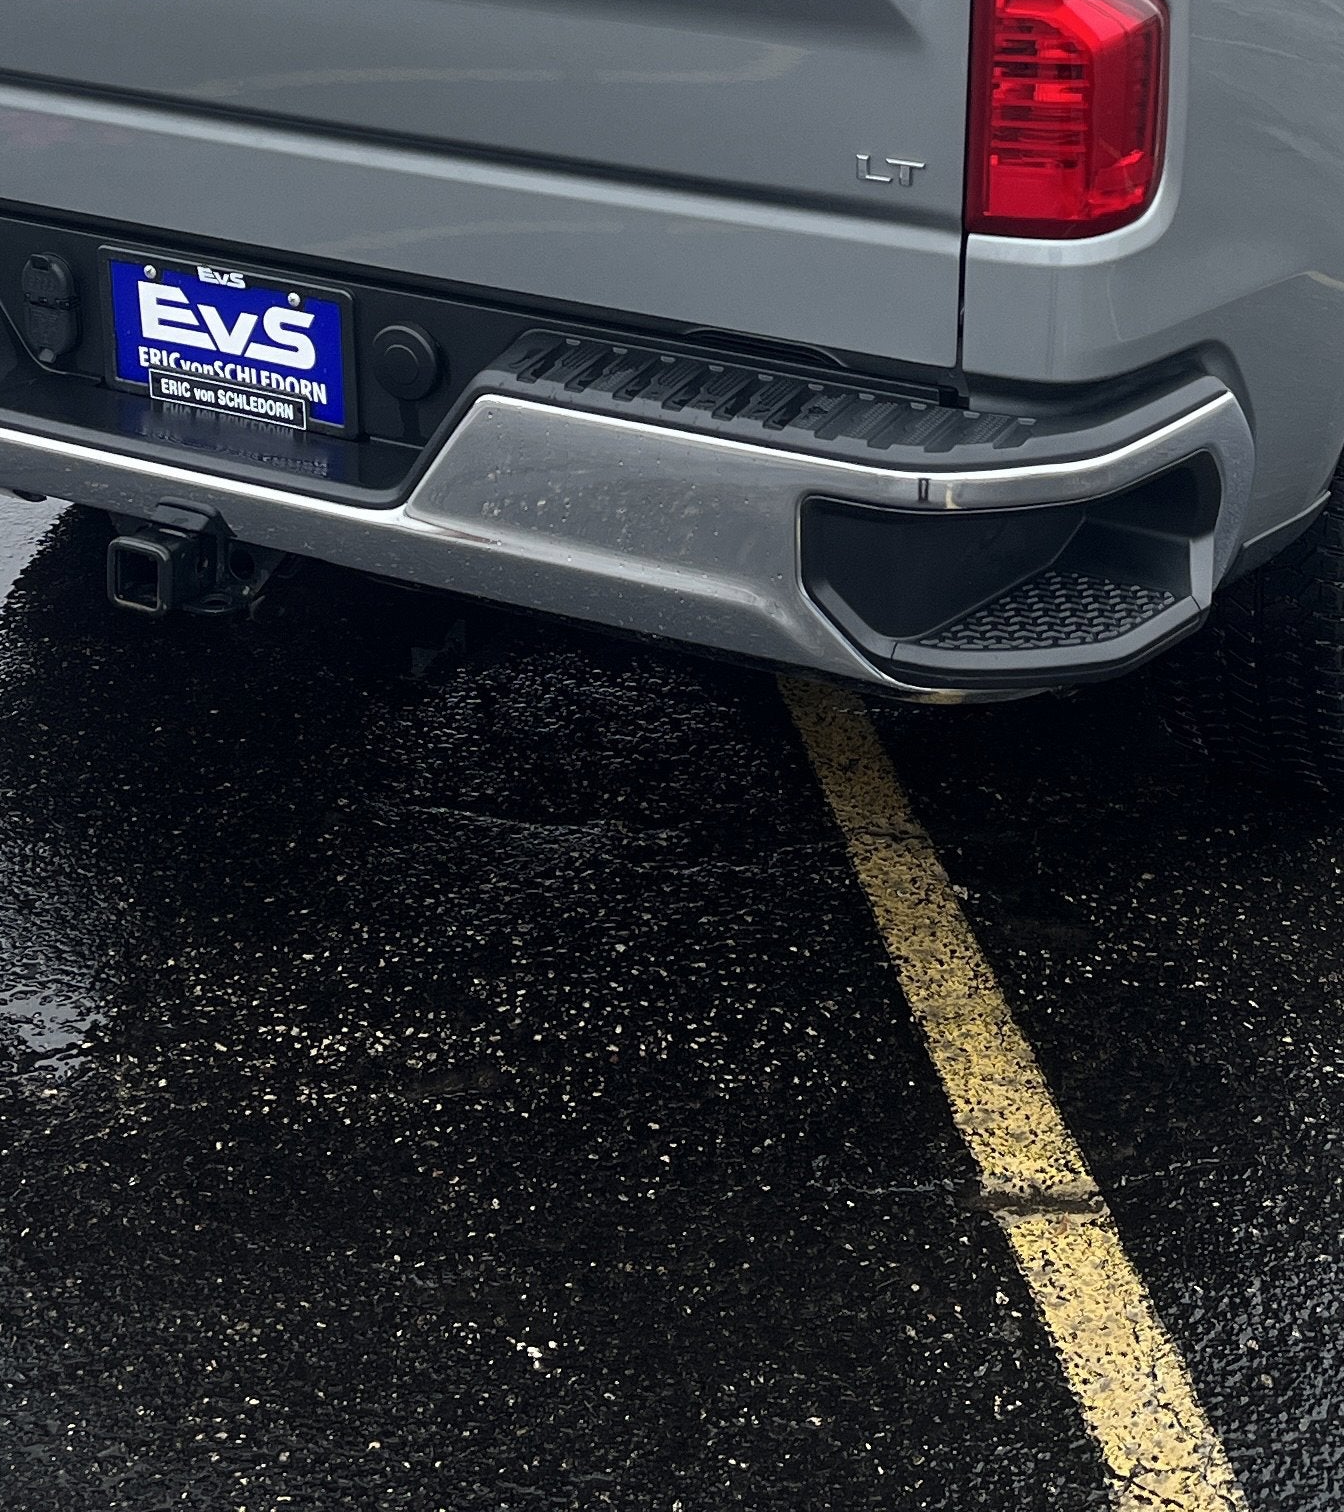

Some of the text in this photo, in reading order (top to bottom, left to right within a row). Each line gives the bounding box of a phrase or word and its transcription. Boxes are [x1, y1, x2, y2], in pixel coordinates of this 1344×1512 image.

[856, 153, 926, 187] LT
[160, 378, 295, 420] ERIC von SCHLEDORN
